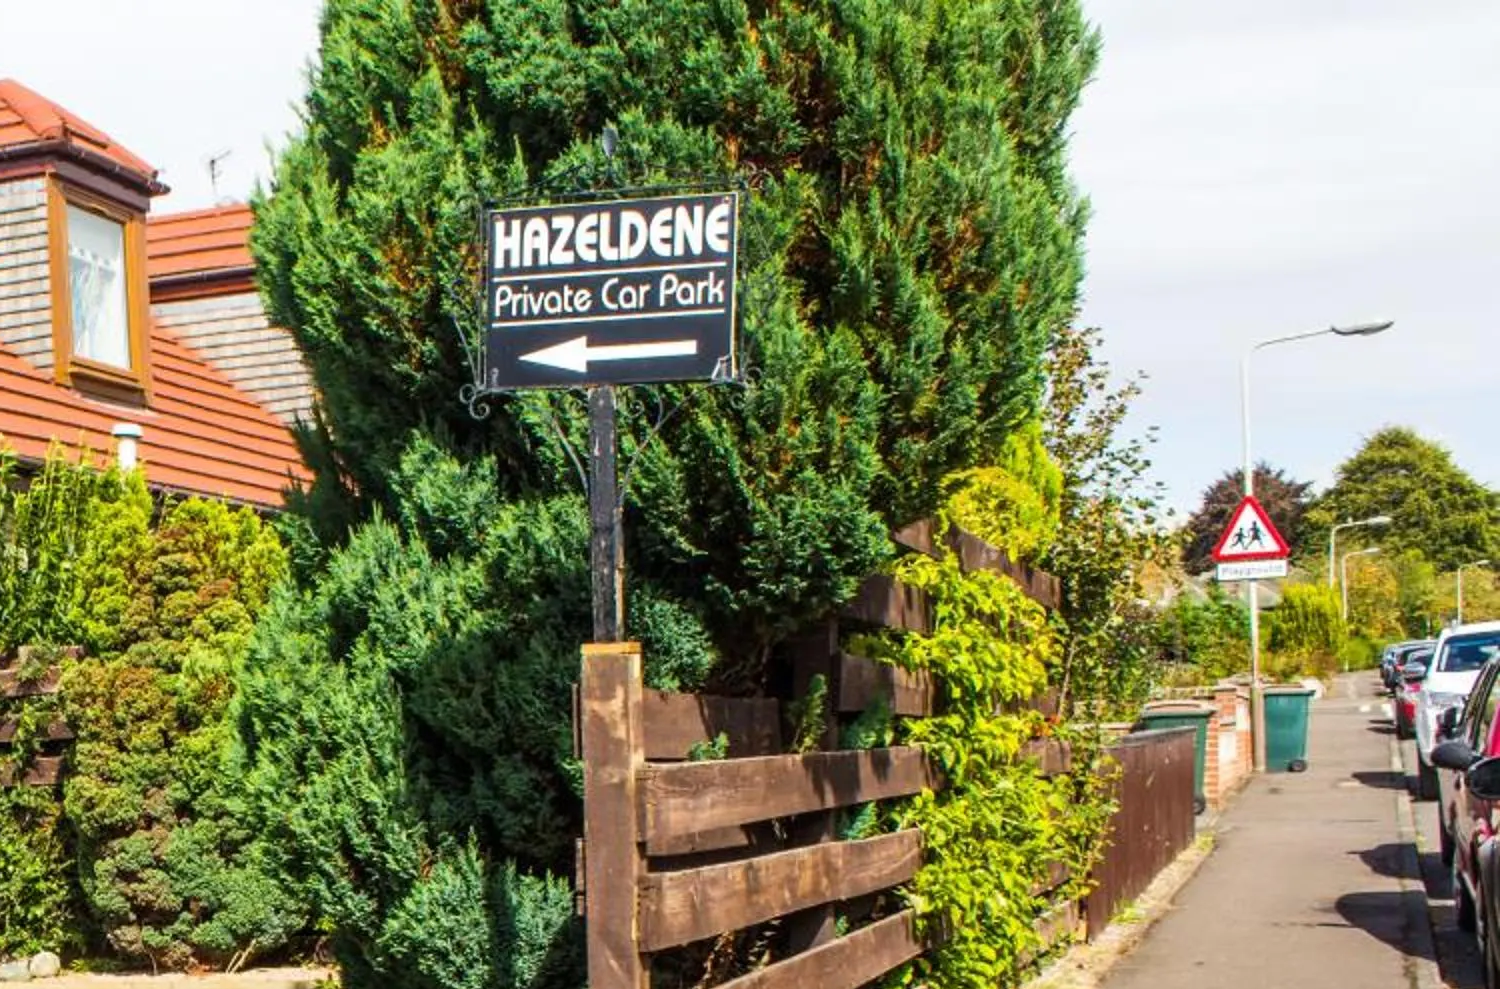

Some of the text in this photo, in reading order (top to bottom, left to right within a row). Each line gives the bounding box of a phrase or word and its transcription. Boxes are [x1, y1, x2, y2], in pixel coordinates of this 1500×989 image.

[493, 204, 730, 269] HAZELDENE
[495, 271, 725, 317] Private Car Park
